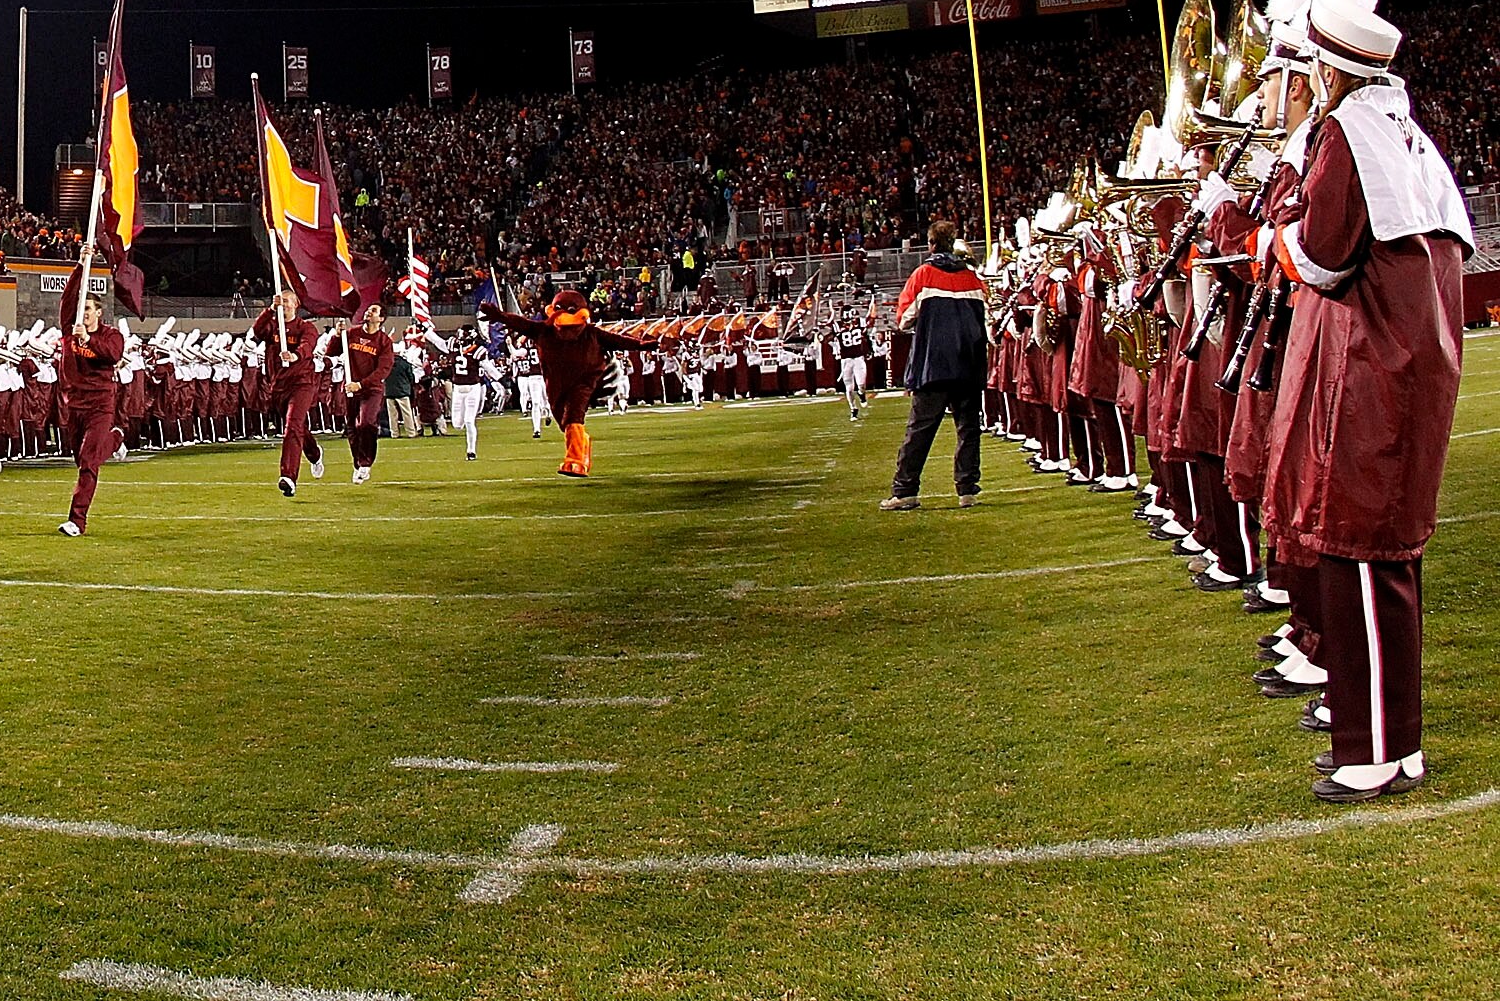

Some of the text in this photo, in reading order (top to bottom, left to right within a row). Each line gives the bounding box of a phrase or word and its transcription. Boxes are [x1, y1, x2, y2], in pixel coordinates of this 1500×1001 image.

[574, 40, 593, 55] 73
[196, 54, 213, 69] 10
[287, 55, 307, 69] 25
[431, 55, 450, 70] 78
[88, 278, 105, 292] IELD
[841, 328, 862, 347] 82
[455, 356, 468, 375] 2
[884, 331, 892, 389] HOKIES
